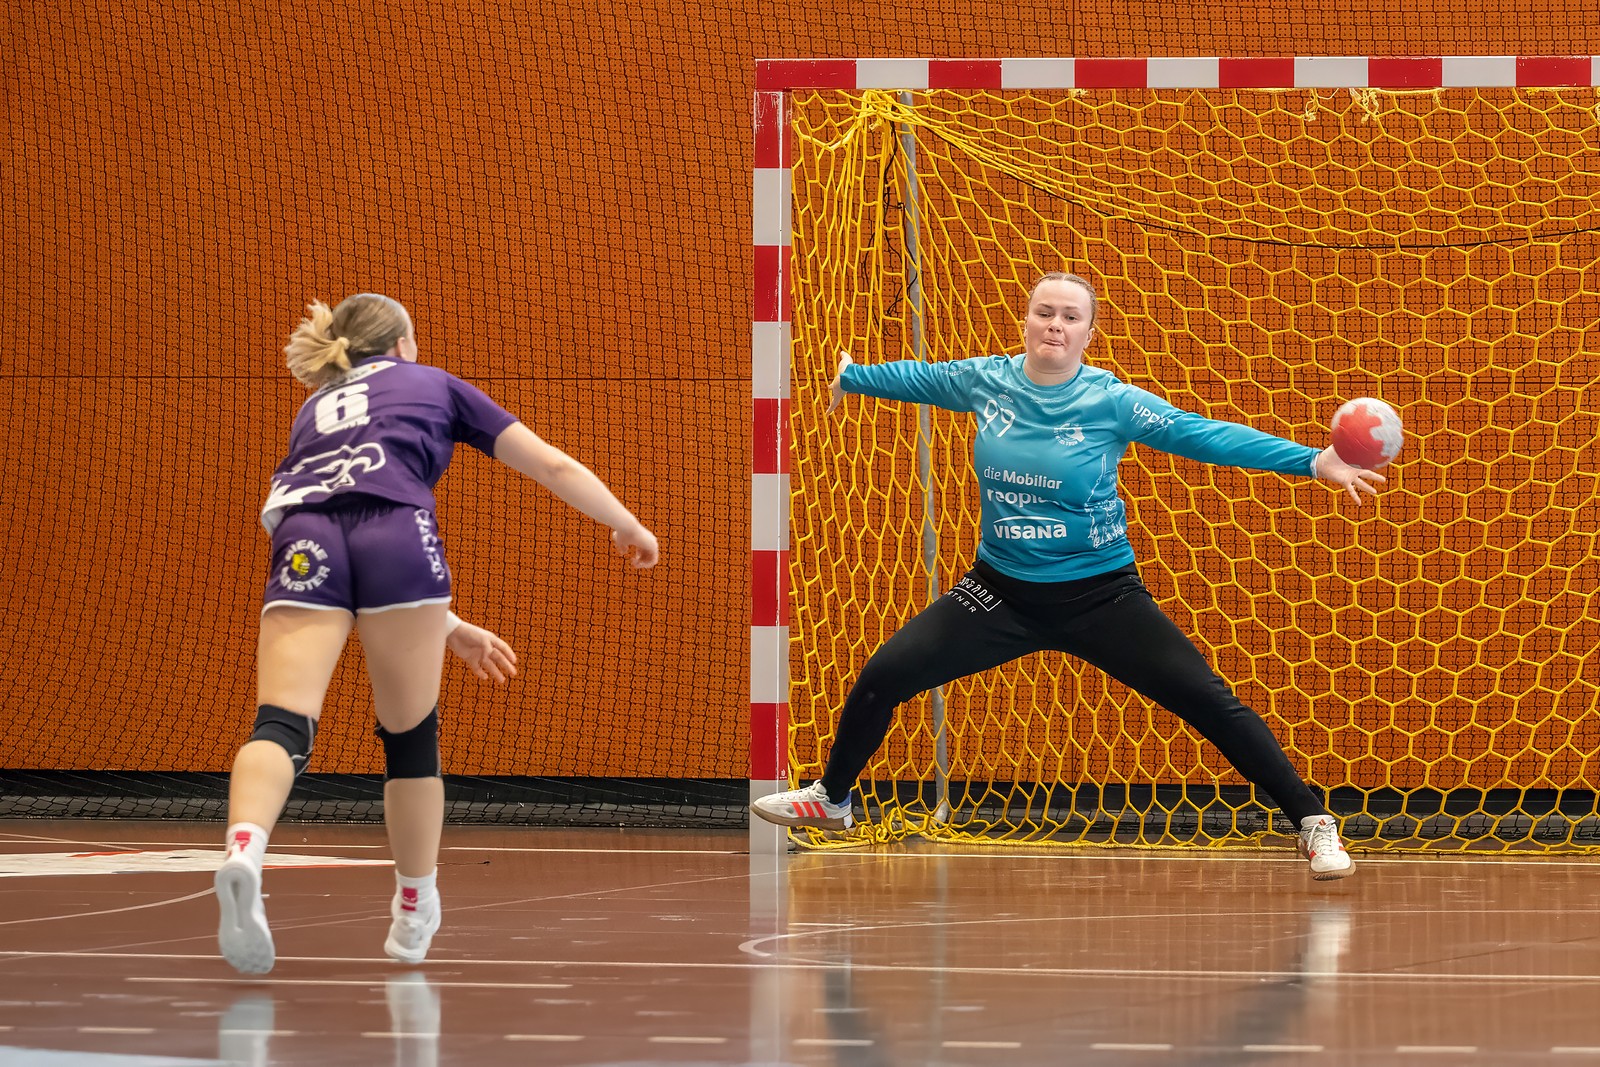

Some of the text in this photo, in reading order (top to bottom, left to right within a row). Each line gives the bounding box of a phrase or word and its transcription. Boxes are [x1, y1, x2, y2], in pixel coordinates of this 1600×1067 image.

[315, 383, 369, 436] 6
[981, 400, 1016, 437] 99
[984, 466, 1062, 489] die Mobiliar
